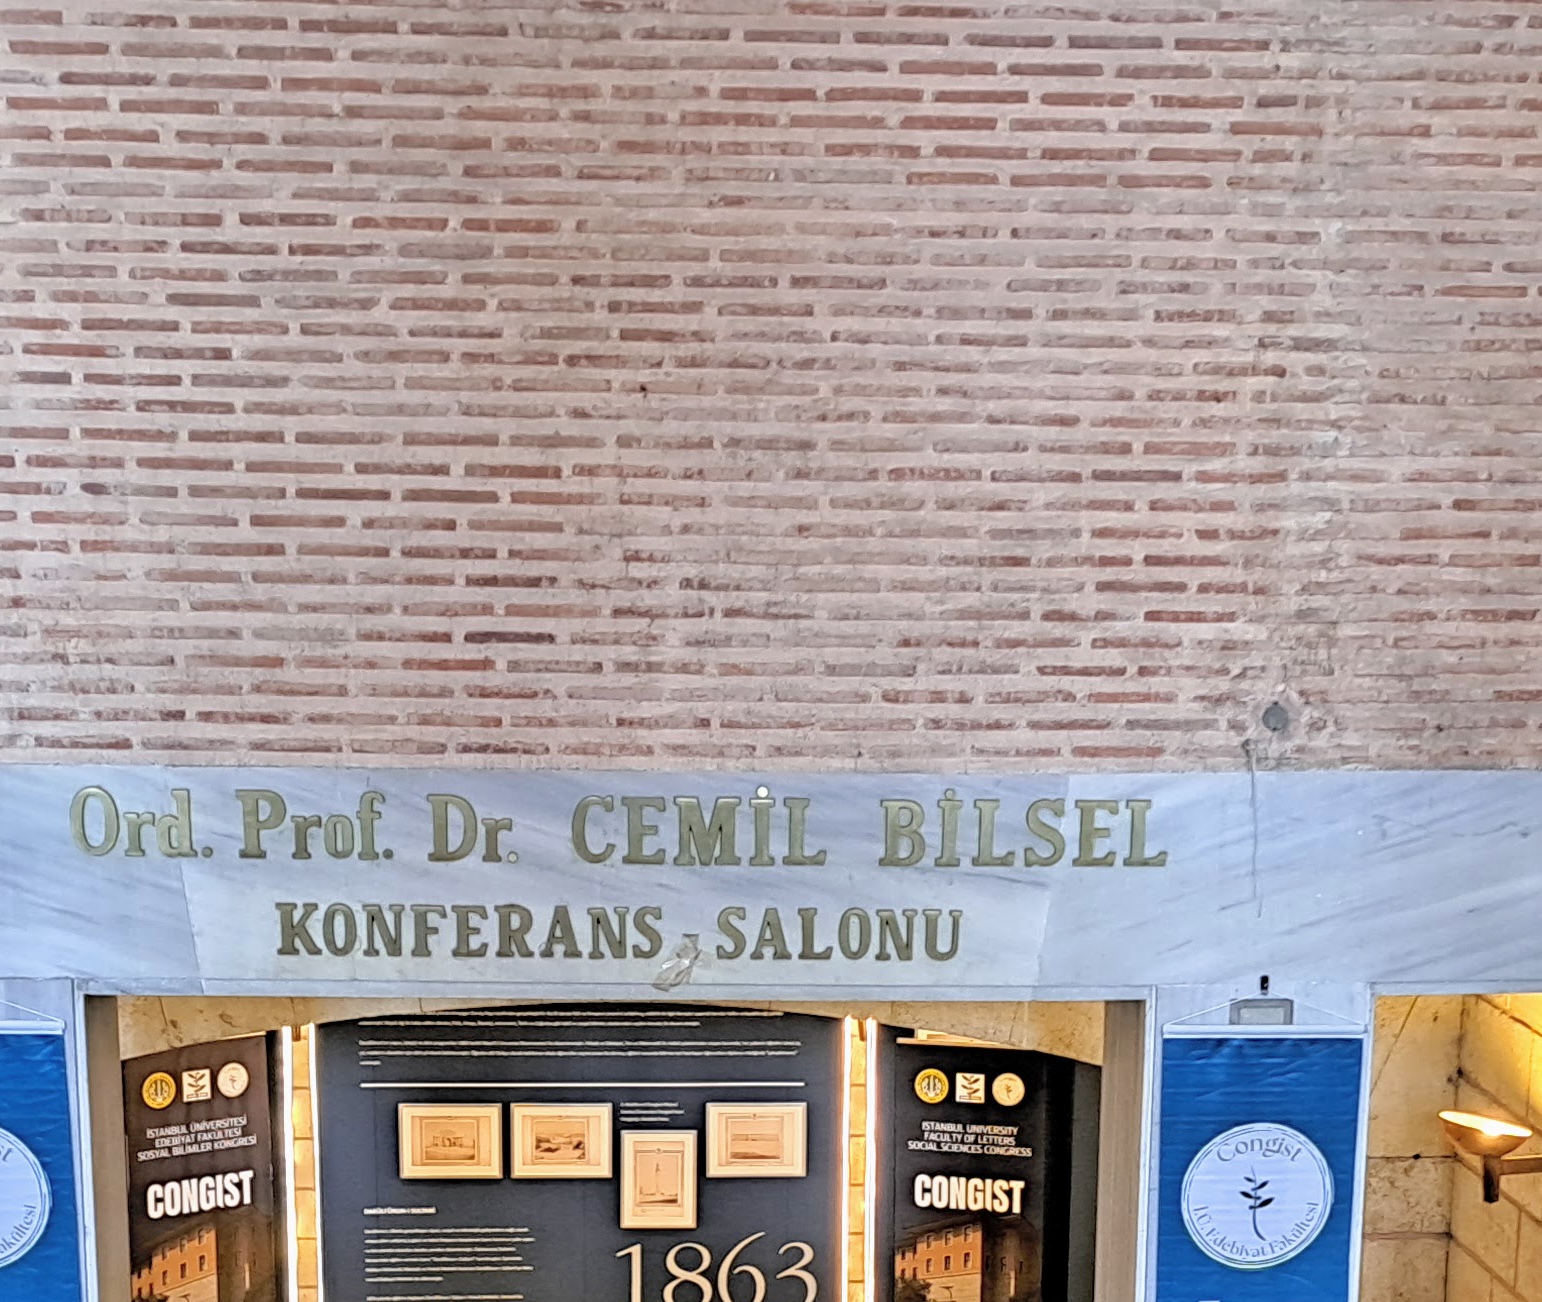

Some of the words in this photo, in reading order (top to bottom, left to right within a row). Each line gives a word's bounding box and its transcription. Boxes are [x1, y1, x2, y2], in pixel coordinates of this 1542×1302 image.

[69, 785, 213, 858] Ord.
[235, 789, 394, 860] Prof.
[426, 793, 518, 863] Dr.
[571, 784, 827, 866] CEMİL
[878, 788, 1168, 867] BİLSEL
[275, 902, 663, 960] KONFERANS
[716, 906, 963, 961] SALONU
[907, 1140, 940, 1151] SOCIAL
[924, 1132, 963, 1142] FACULTY
[964, 1134, 976, 1143] OF
[1217, 1137, 1303, 1163] Congist
[146, 1169, 255, 1219] CONGIST
[914, 1173, 1026, 1214] CONGIST
